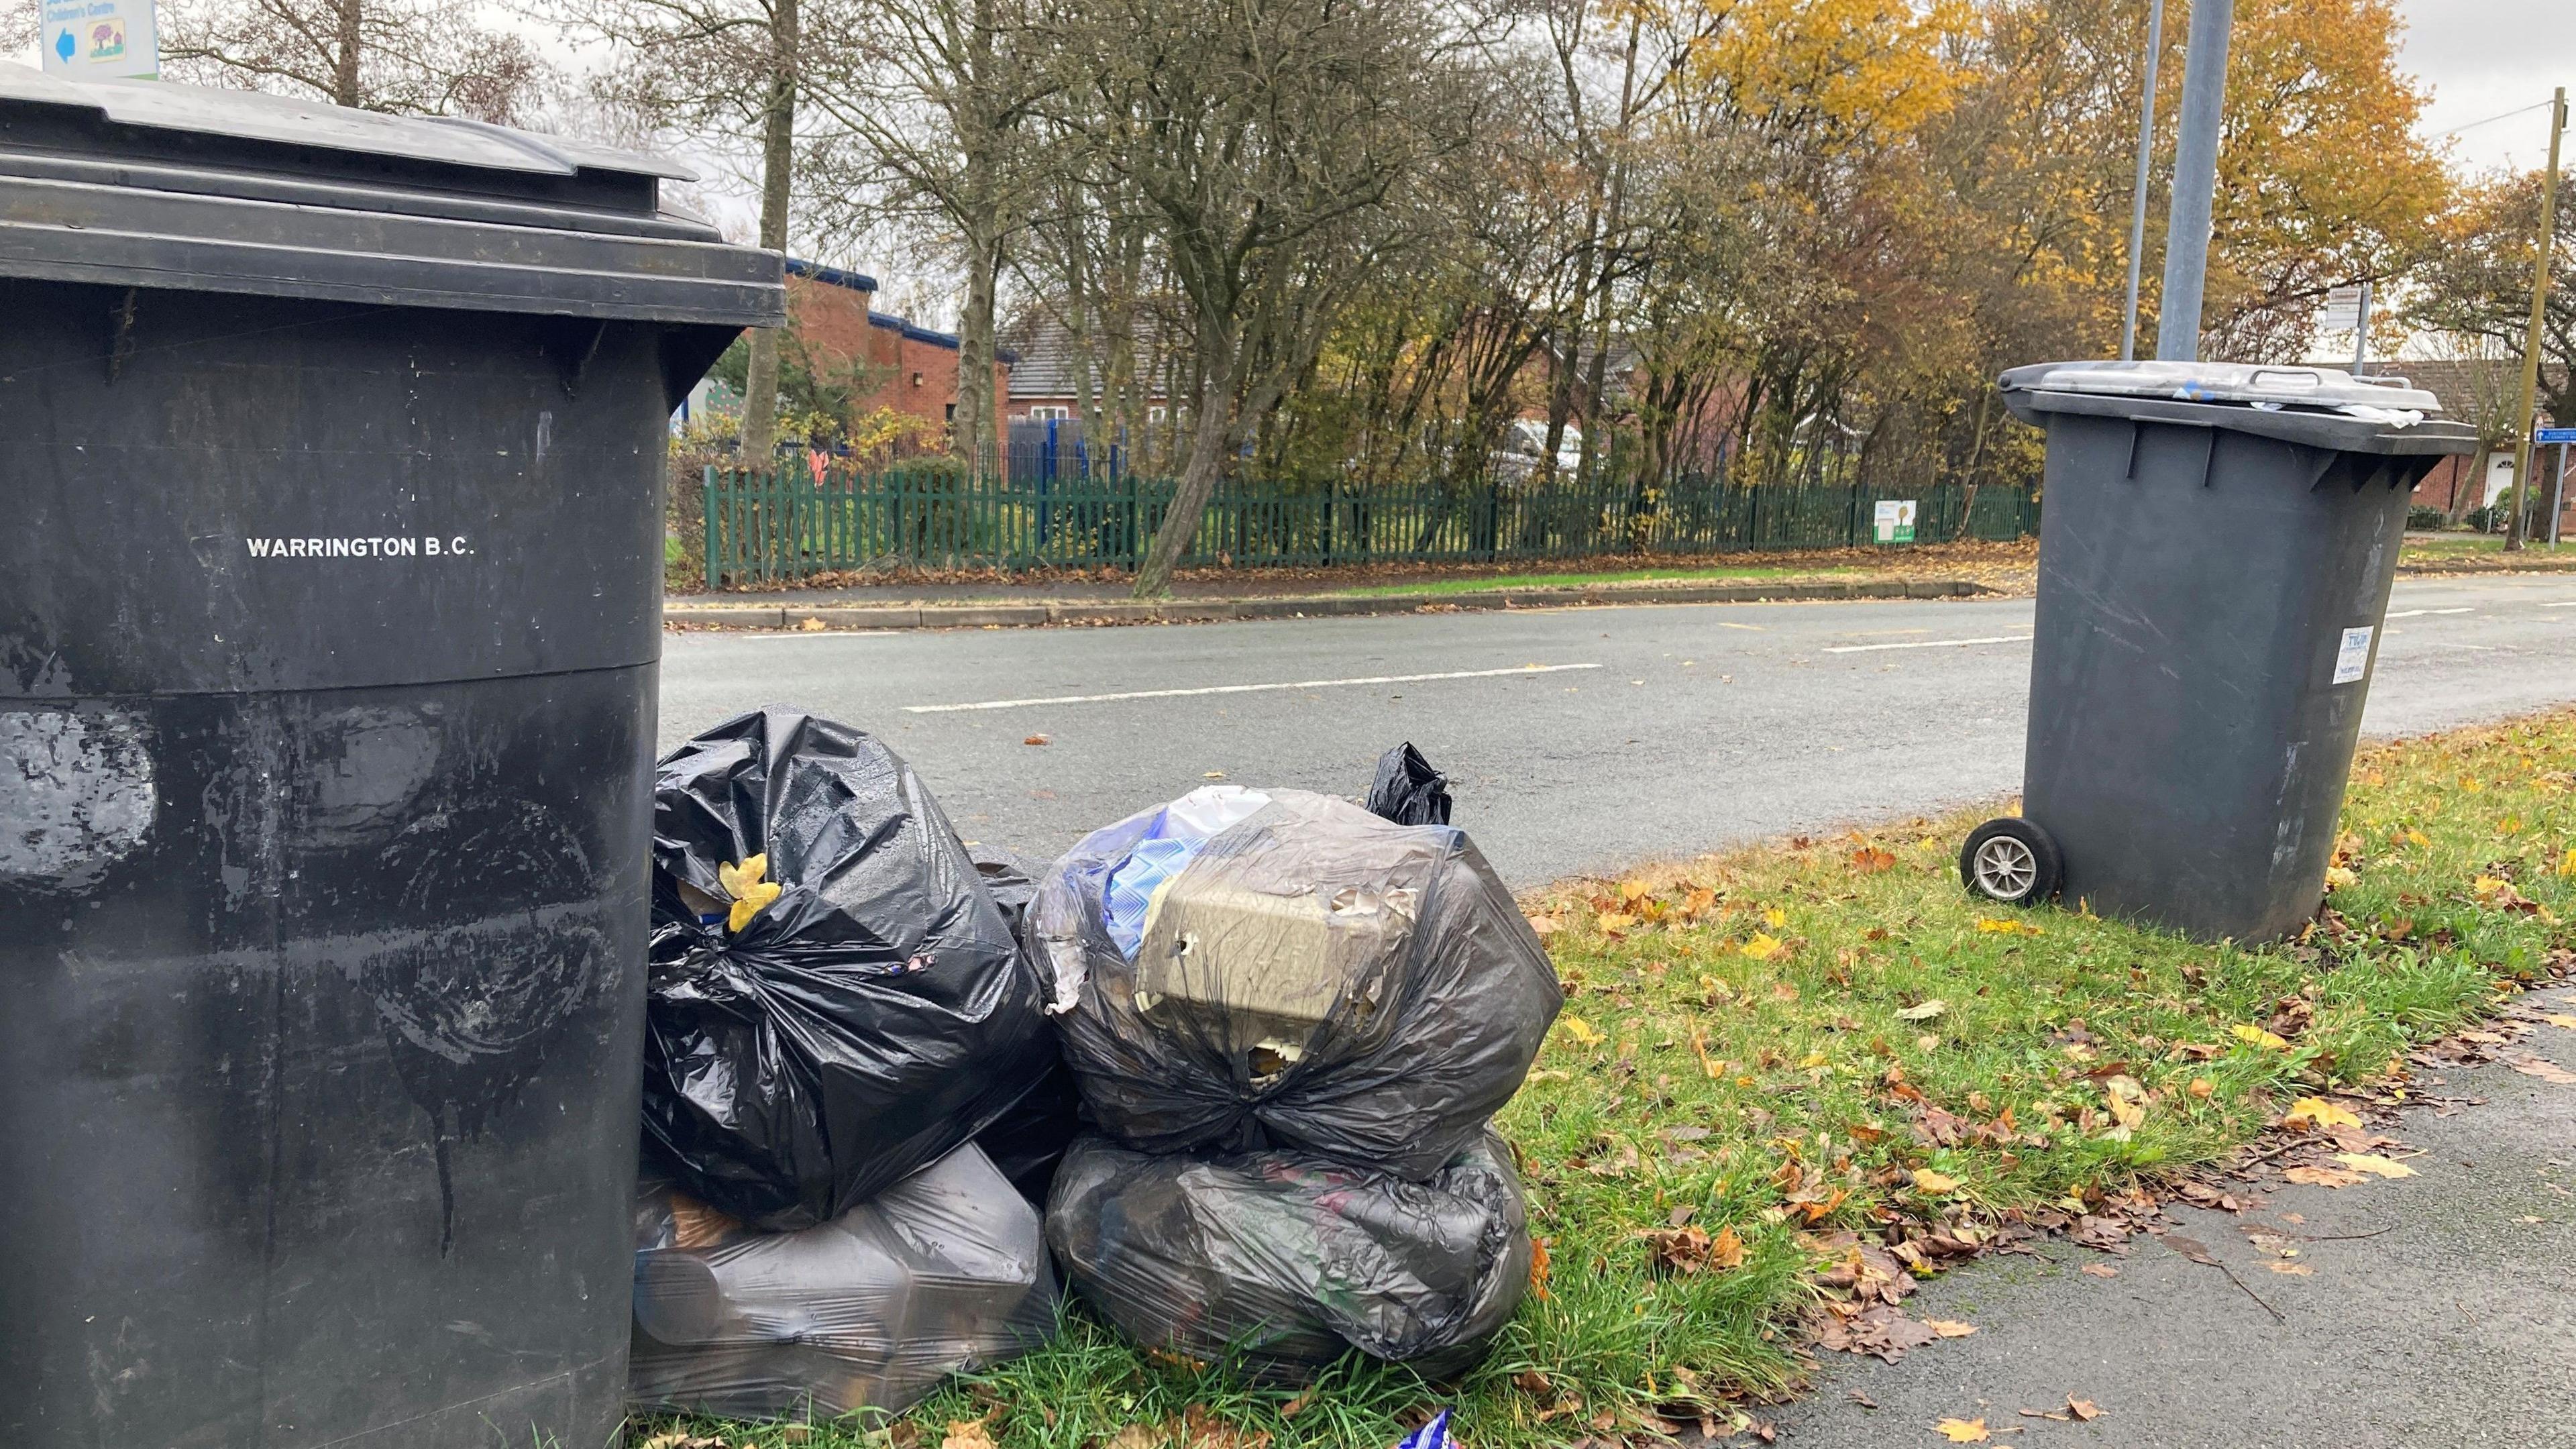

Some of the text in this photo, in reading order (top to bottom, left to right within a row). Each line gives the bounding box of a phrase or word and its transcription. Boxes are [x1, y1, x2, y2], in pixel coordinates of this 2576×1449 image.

[47, 7, 85, 22] Children's
[87, 3, 114, 15] Centre
[246, 535, 475, 557] WARRINGTON B.C.
